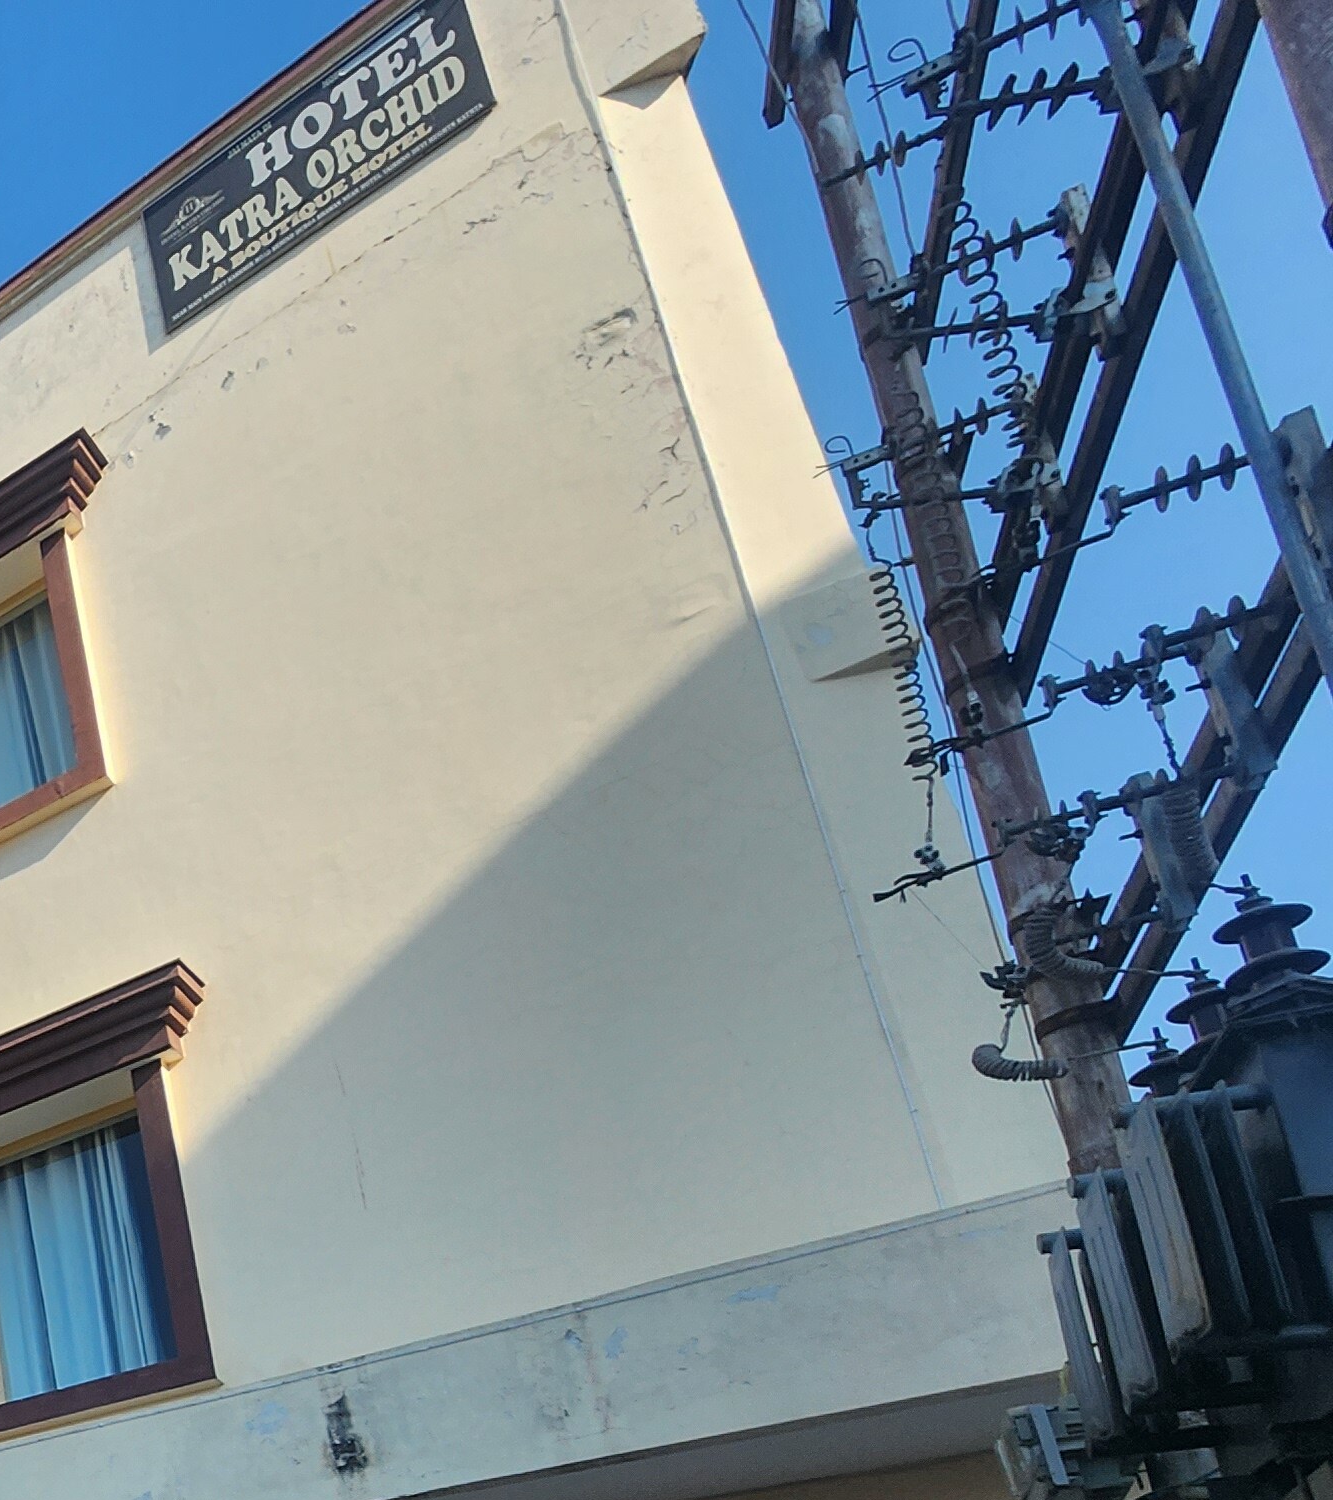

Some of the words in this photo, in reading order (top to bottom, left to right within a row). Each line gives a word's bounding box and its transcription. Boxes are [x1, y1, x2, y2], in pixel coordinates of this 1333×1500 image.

[168, 177, 303, 291] KATRA
[305, 56, 466, 189] ORCHID
[244, 17, 456, 188] HOTEL
[211, 266, 229, 284] A
[230, 178, 349, 269] BOUTIQUE
[350, 122, 433, 184] HOTEL
